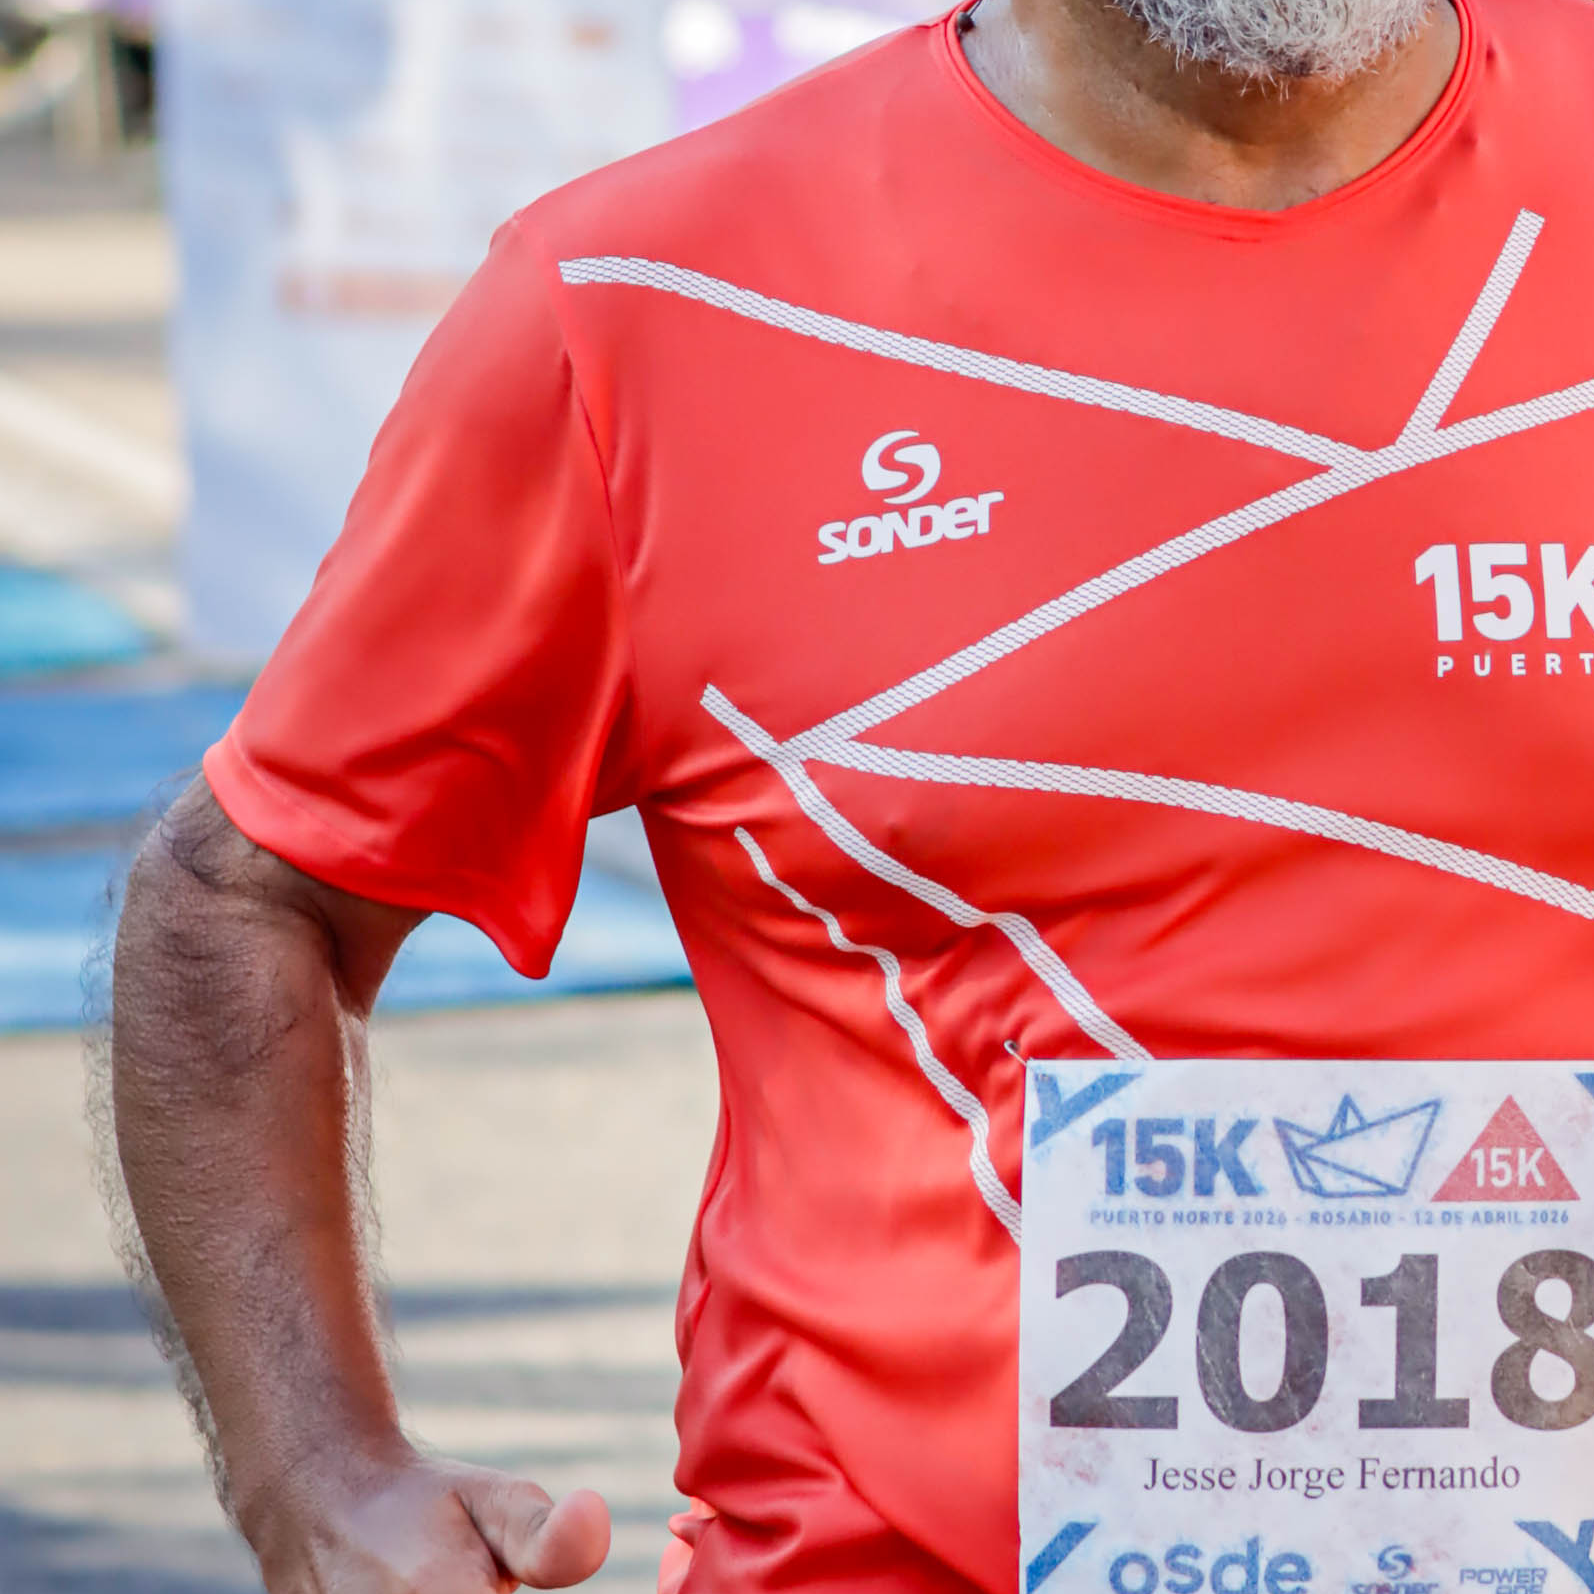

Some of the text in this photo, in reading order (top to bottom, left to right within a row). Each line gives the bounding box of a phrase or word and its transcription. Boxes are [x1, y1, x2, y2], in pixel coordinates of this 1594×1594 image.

[1092, 1117, 1266, 1199] 15K
[1470, 1147, 1546, 1189] 15K
[1090, 1210, 1166, 1226] PUERTO
[1172, 1210, 1235, 1226] NORTE
[1242, 1210, 1288, 1226] 2026
[1309, 1209, 1392, 1226] ROSARIO
[1414, 1209, 1435, 1226] 12
[1441, 1209, 1463, 1226] DE
[1471, 1209, 1523, 1225] ABRIL
[1530, 1209, 1569, 1225] 2026
[1143, 1456, 1521, 1500] Jesse Jorge Fernando
[1460, 1567, 1548, 1585] POWER
